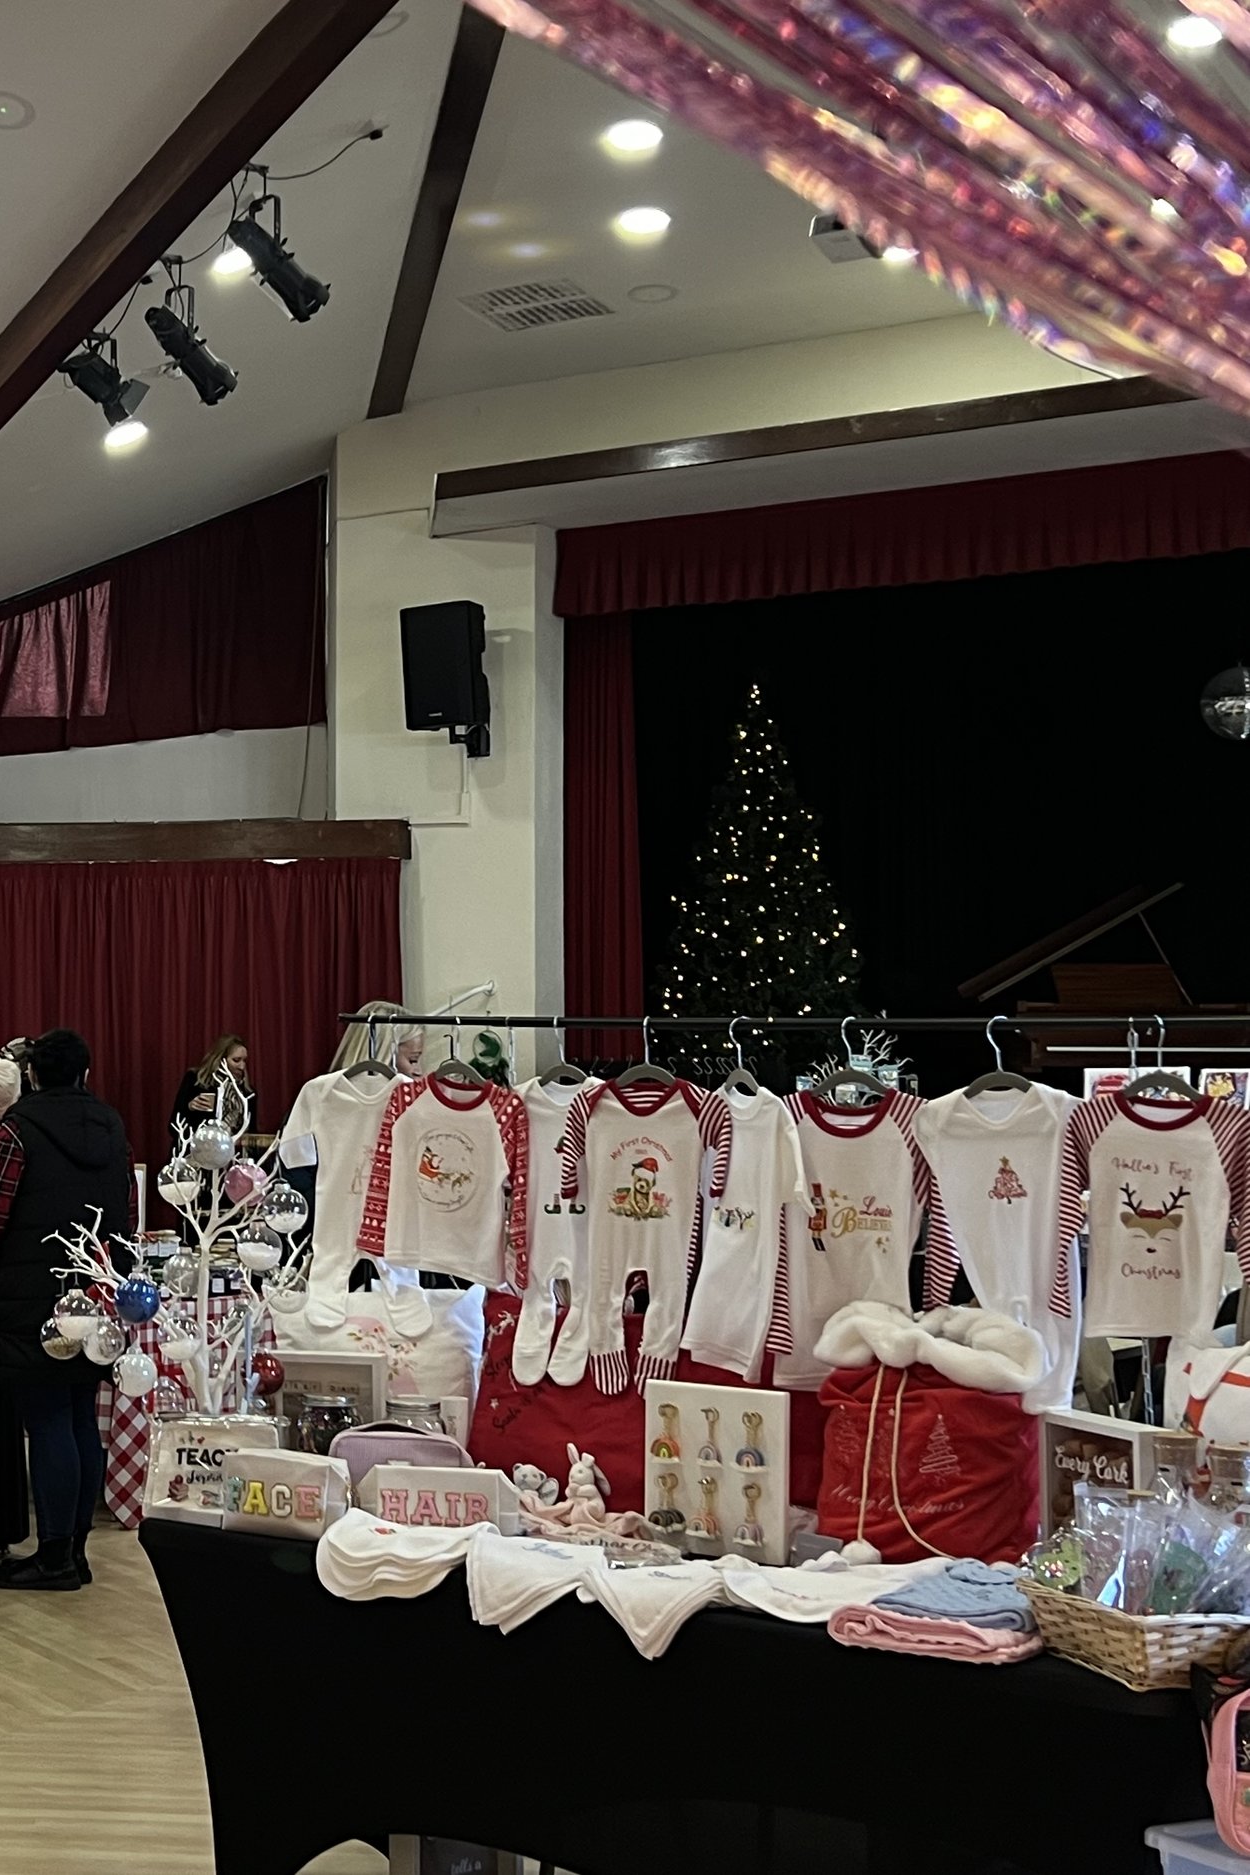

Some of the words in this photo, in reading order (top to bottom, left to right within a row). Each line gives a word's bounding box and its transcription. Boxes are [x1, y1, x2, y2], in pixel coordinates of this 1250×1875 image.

[176, 1448, 239, 1467] TEAC
[1092, 1455, 1128, 1484] Cork
[226, 1476, 323, 1520] FACE
[380, 1488, 490, 1527] HAIR
